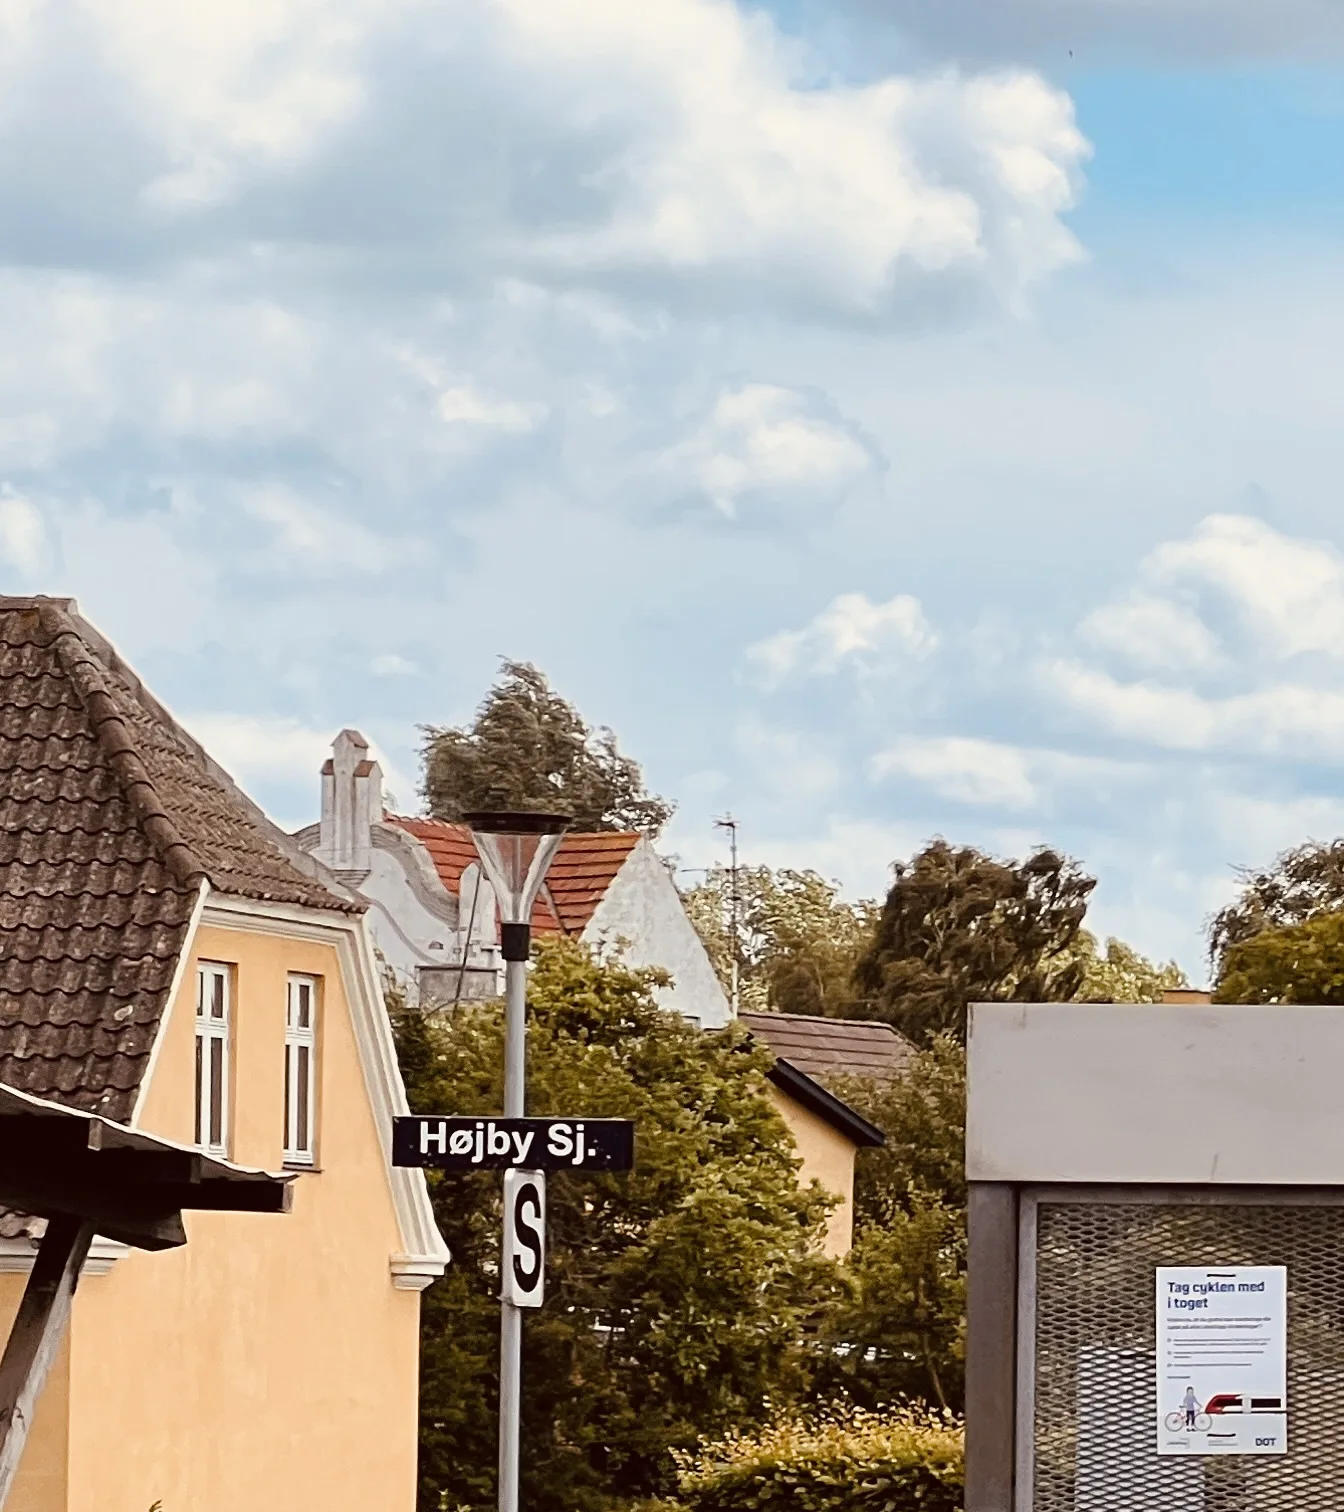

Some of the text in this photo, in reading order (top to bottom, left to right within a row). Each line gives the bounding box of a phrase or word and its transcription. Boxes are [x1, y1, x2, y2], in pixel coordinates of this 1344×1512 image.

[420, 1121, 597, 1165] Højby Sj.
[513, 1182, 541, 1292] S
[1167, 1281, 1265, 1295] Tag cyklen med
[1167, 1298, 1208, 1310] i toget
[1255, 1438, 1276, 1447] DOT
